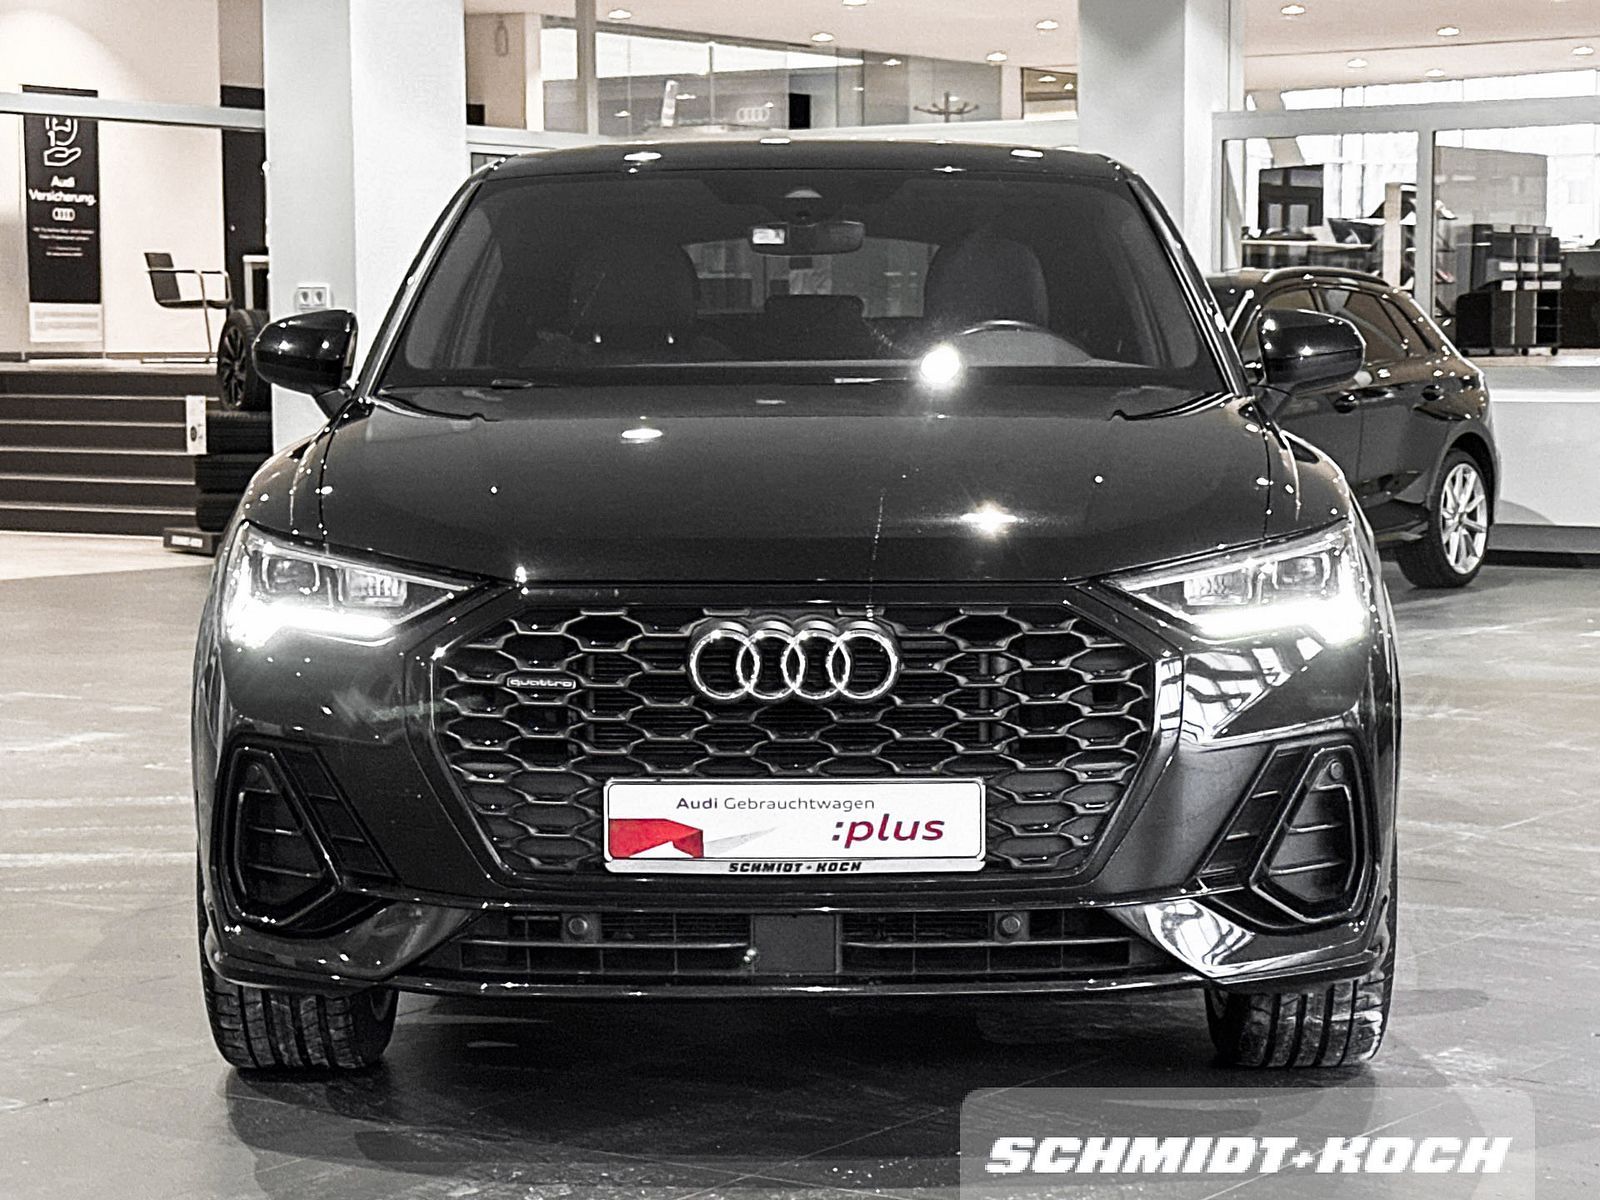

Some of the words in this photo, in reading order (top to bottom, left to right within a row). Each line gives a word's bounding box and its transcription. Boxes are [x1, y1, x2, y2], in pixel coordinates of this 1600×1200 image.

[510, 679, 573, 688] quattro
[676, 797, 718, 810] Audi
[724, 797, 875, 813] Gebrauchtwagen
